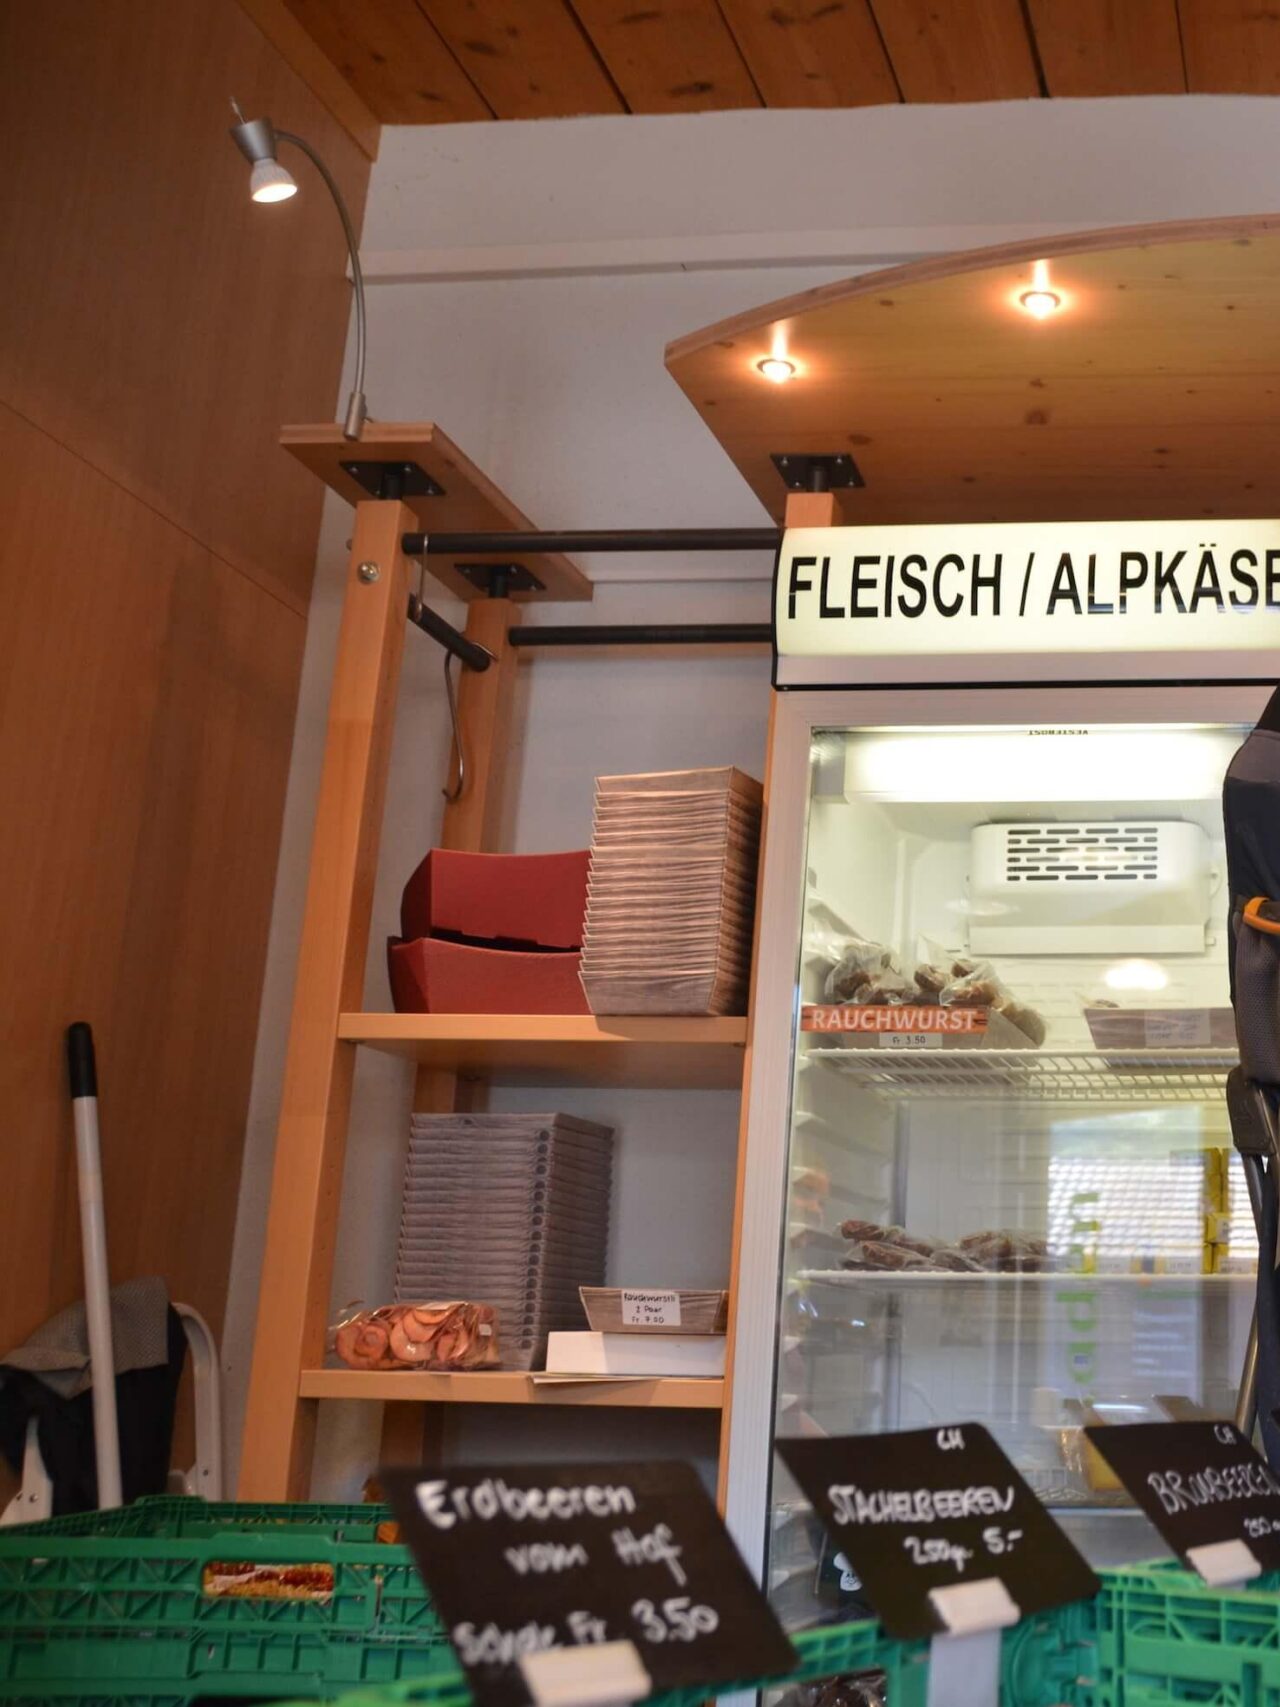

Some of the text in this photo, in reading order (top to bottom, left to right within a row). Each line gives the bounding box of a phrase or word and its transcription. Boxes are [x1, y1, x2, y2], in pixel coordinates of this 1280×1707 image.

[787, 554, 1002, 619] FLEISCH
[1019, 552, 1036, 617] /
[812, 1009, 978, 1030] RAUCHWURST
[415, 1478, 637, 1530] Erdbeeren
[504, 1522, 688, 1587] vom Hof
[631, 1597, 719, 1643] 3.50
